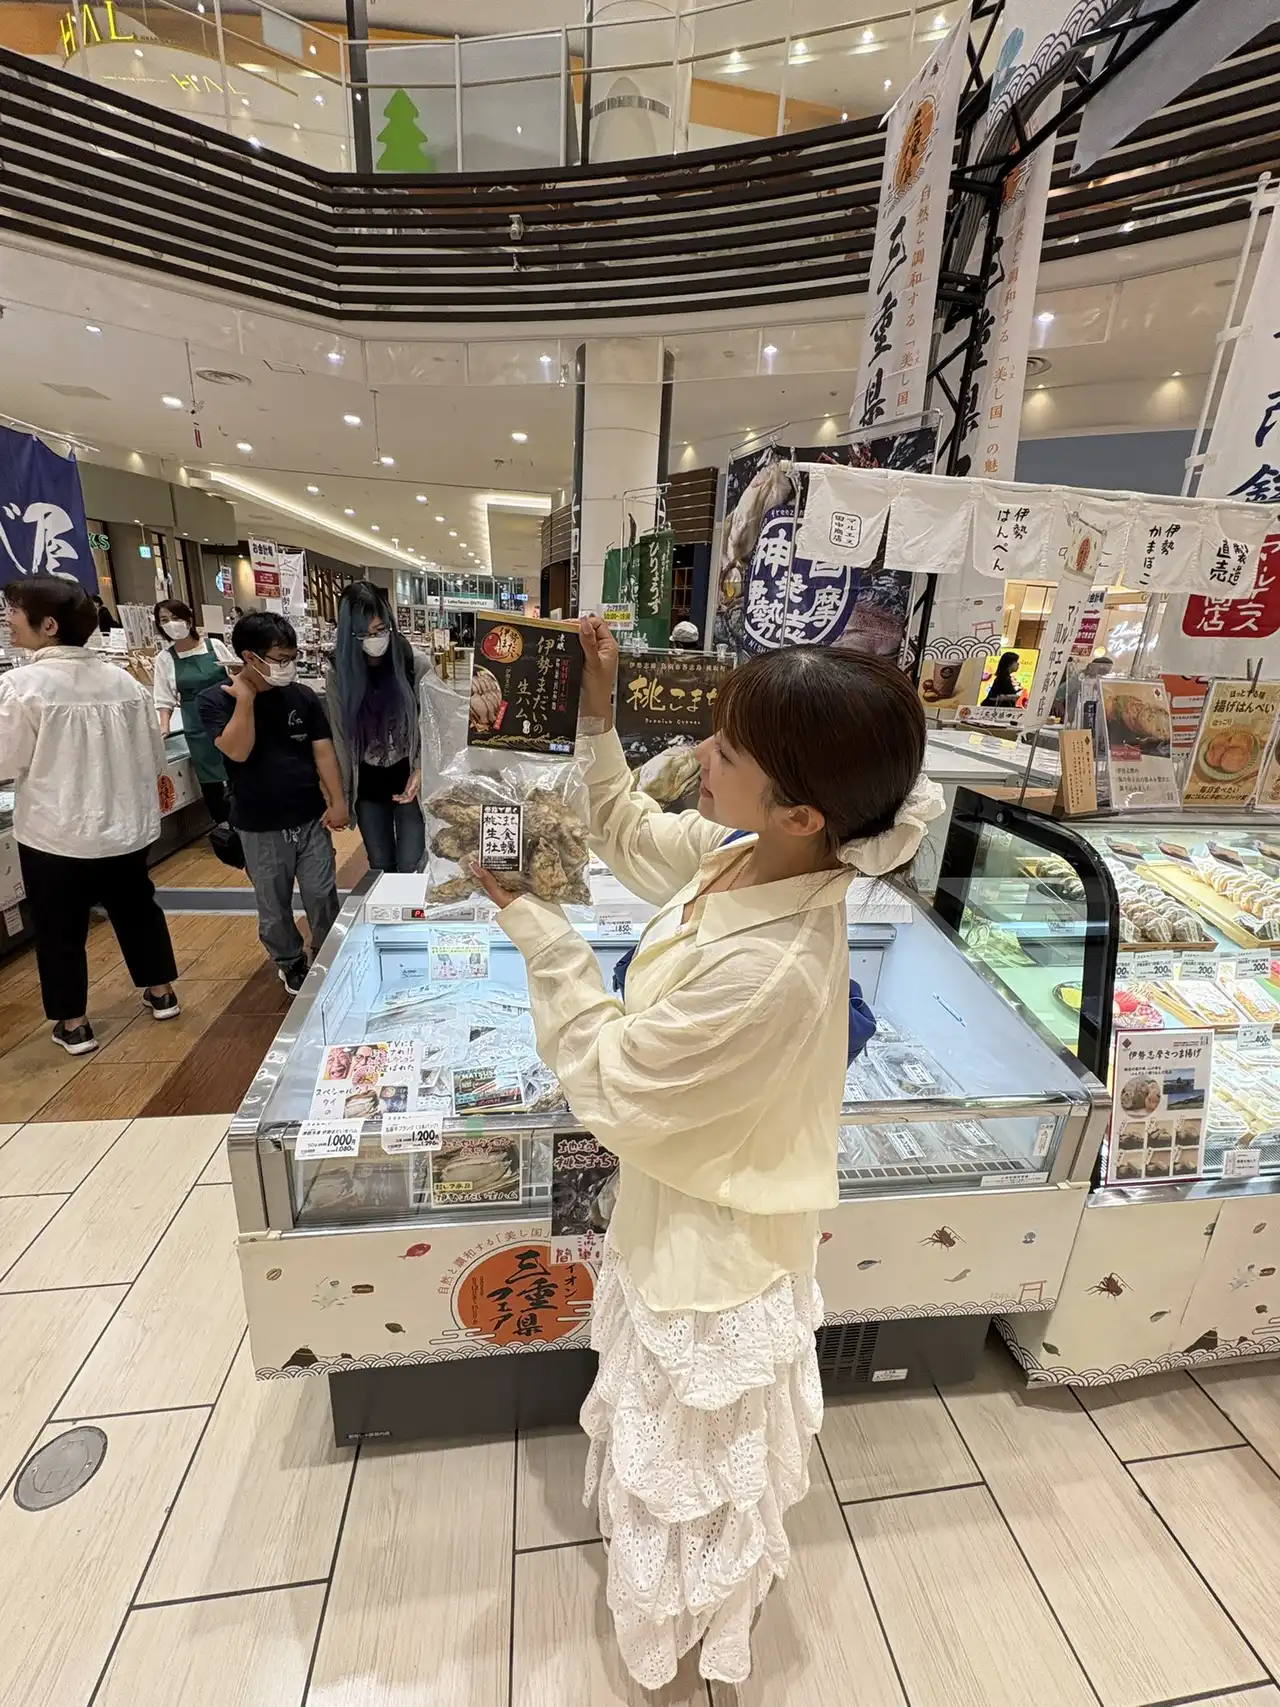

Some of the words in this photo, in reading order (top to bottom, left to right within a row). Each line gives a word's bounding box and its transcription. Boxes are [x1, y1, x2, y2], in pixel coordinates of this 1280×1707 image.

[60, 1, 136, 58] HAL
[993, 508, 1012, 572] はんぺん
[1012, 506, 1031, 540] 伊勢
[1160, 523, 1182, 556] 伊勢
[647, 541, 661, 615] ひりょうず
[1138, 525, 1162, 586] かまぼこ
[1208, 538, 1232, 583] 直売
[1226, 542, 1249, 586] 製造
[515, 678, 532, 720] 生ハム
[532, 635, 556, 735] 伊勢まだいの
[486, 1286, 515, 1332] フェア
[505, 1249, 560, 1338] 三重県
